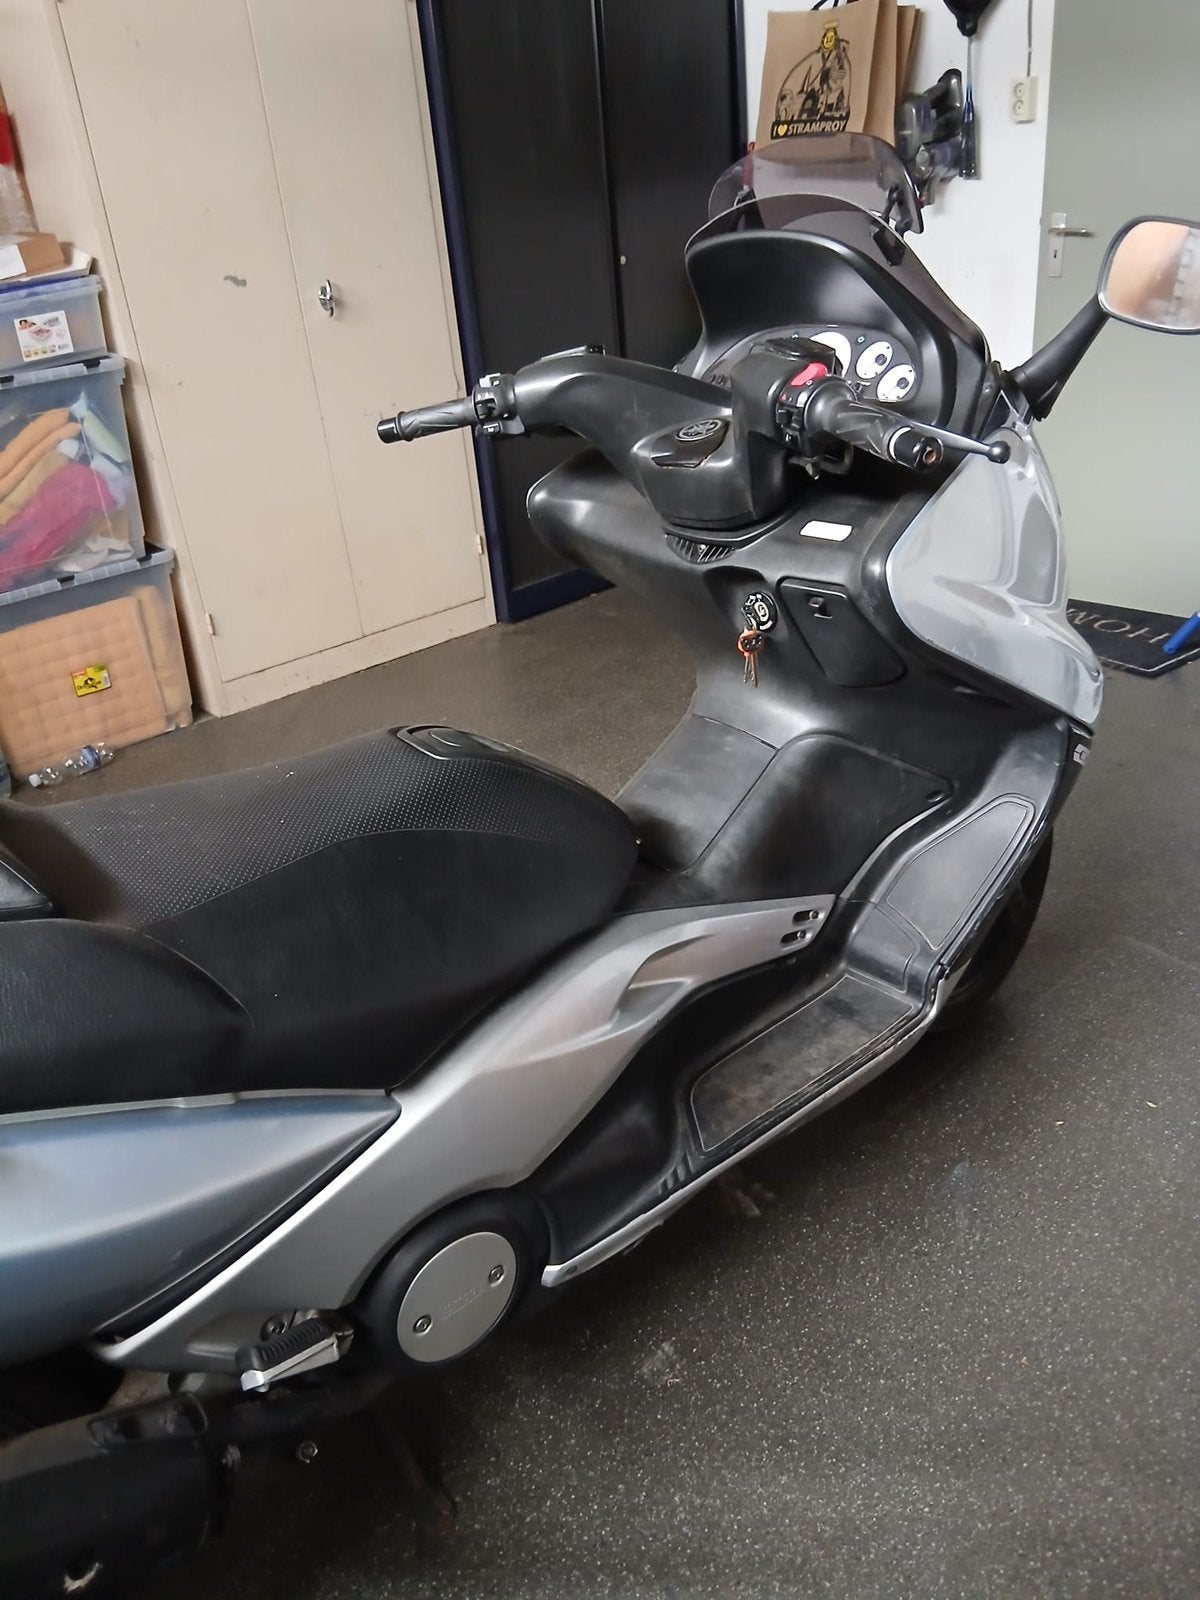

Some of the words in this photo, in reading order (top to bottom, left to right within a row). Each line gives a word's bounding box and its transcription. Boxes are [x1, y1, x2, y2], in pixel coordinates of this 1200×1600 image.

[773, 125, 778, 137] I
[787, 120, 846, 136] STRAMPROY
[1066, 608, 1171, 644] HOM
